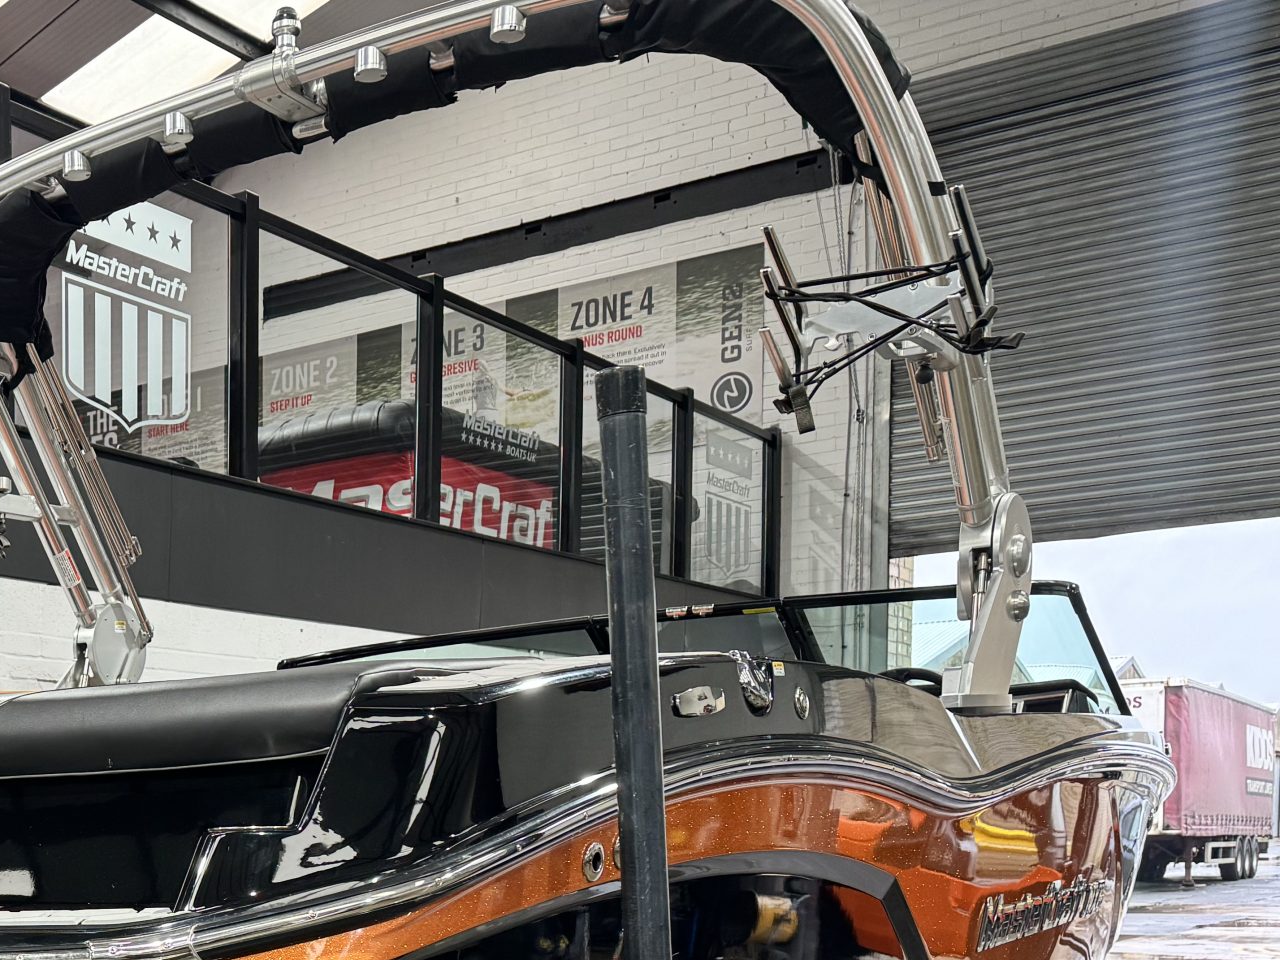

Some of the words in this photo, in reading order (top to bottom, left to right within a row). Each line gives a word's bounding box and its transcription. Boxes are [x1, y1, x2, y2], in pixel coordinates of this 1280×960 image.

[65, 239, 188, 302] MasterCraft
[570, 290, 633, 331] ZONE
[640, 286, 654, 315] 4
[411, 327, 466, 365] ZNE
[473, 323, 485, 352] 3
[582, 332, 605, 348] NUS
[607, 325, 644, 343] ROUND
[271, 359, 321, 395] ZONE
[325, 356, 338, 385] 2
[441, 358, 479, 376] GRESIVE
[270, 399, 290, 414] STEP
[291, 396, 300, 409] IT
[301, 393, 313, 407] UP
[147, 424, 169, 439] START
[170, 420, 190, 435] HERE
[463, 409, 540, 450] MasterCraft
[505, 444, 526, 460] BOATS
[527, 451, 537, 463] UK
[706, 471, 751, 499] MasterCraft
